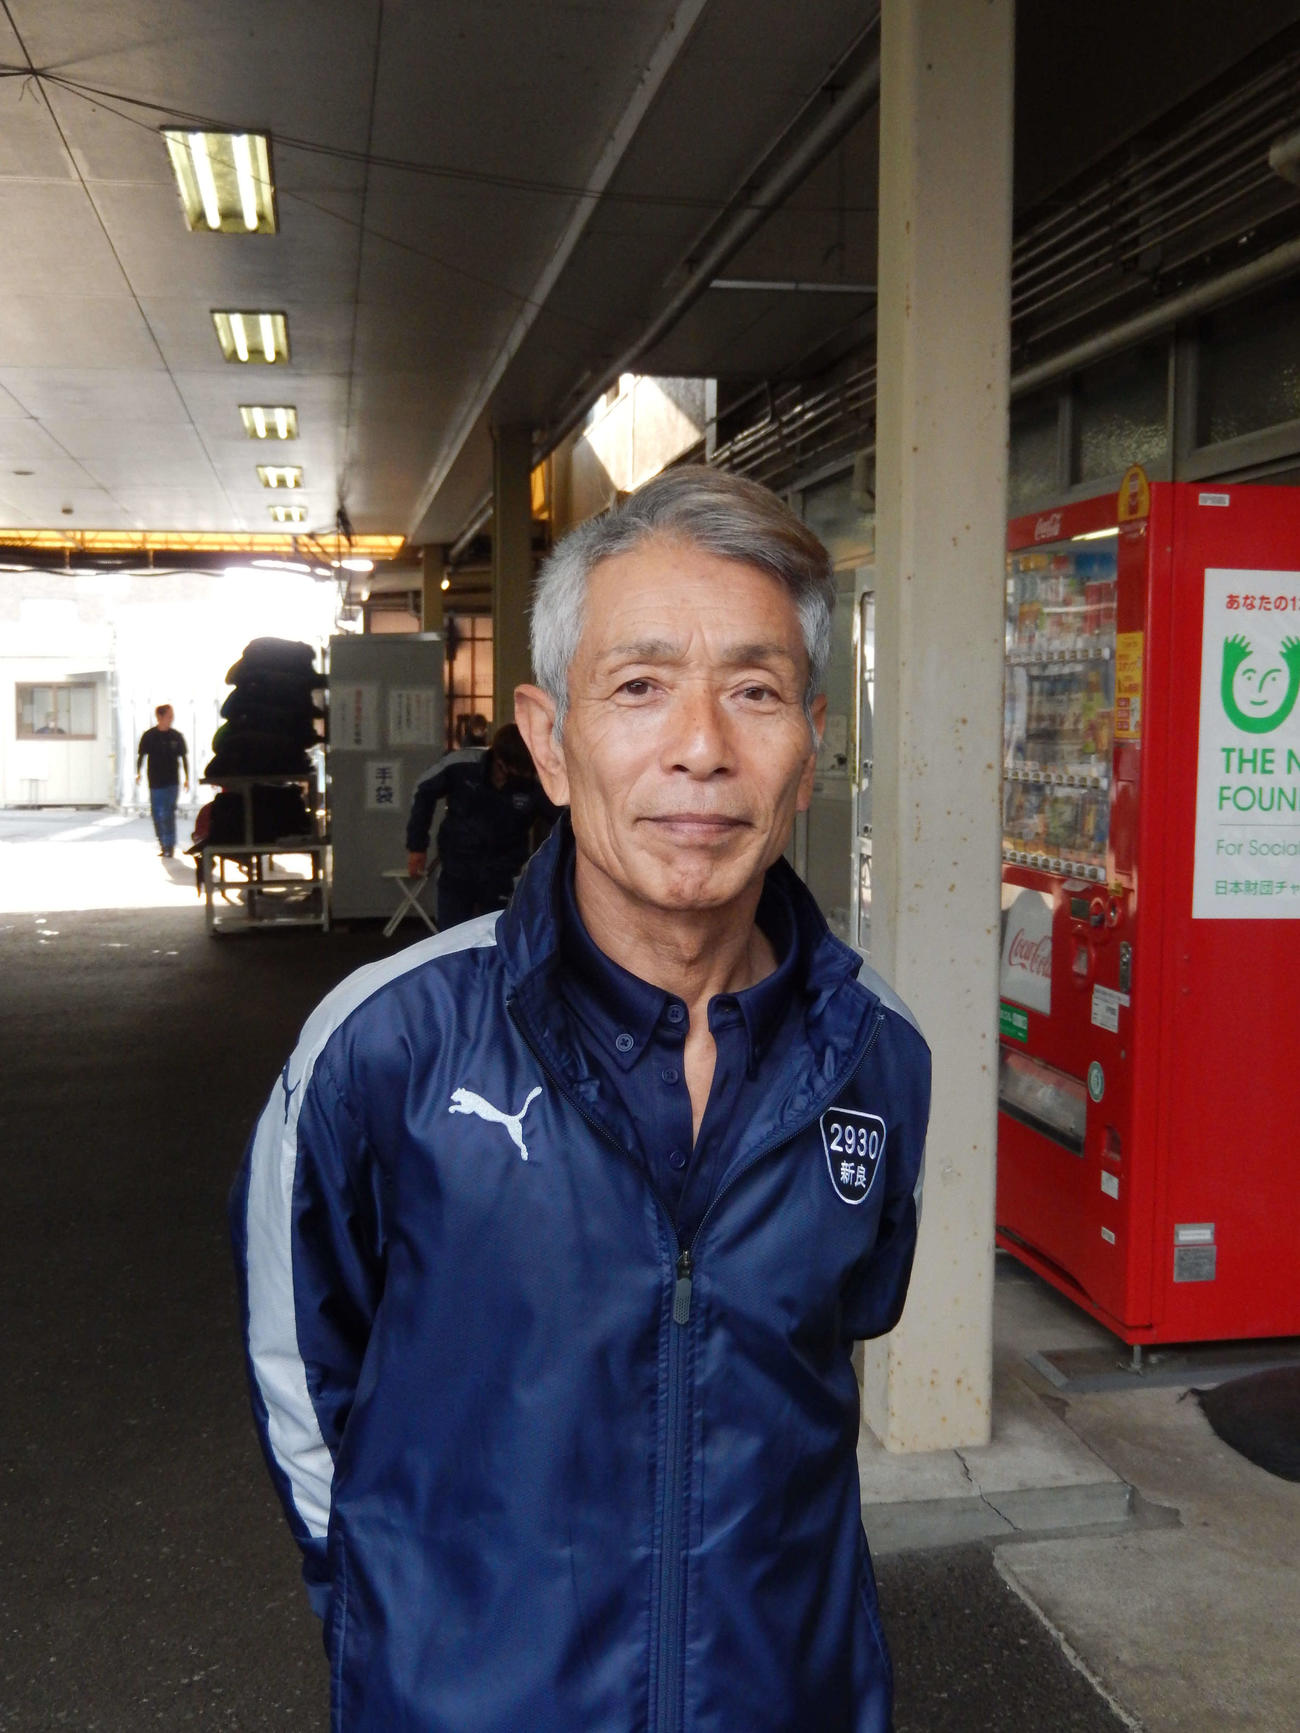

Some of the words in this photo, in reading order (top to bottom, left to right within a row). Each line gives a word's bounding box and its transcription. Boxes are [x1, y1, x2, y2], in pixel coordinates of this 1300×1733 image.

[1226, 593, 1300, 611] あなたの1
[1221, 747, 1275, 775] THE
[1218, 786, 1300, 812] FOUN
[1216, 839, 1243, 856] For
[830, 1123, 879, 1160] 2930
[840, 1160, 867, 1189] 新良
